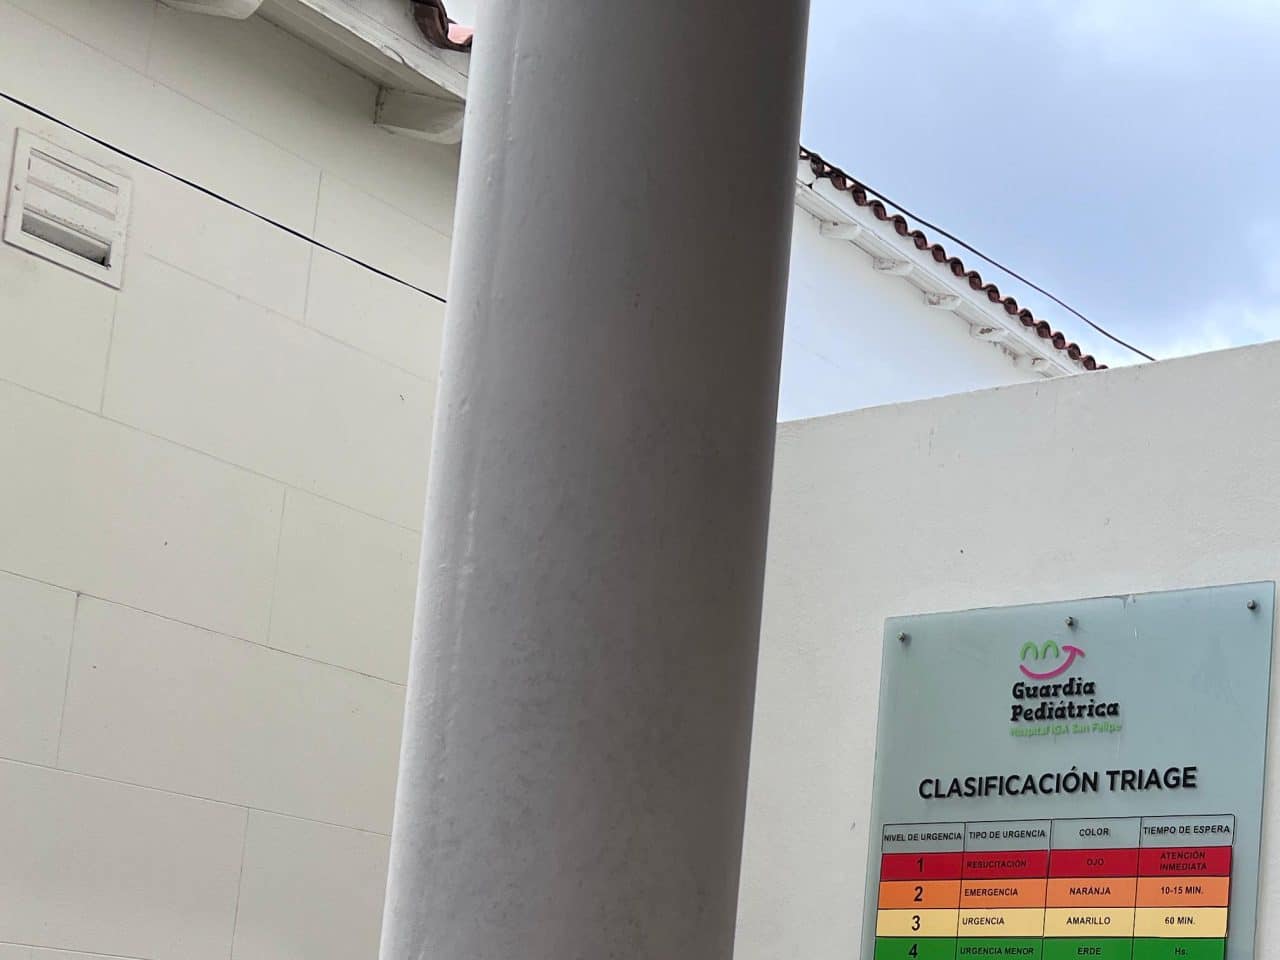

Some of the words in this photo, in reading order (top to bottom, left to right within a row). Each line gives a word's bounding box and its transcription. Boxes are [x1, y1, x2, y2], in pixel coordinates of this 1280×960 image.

[1012, 677, 1096, 700] Guardia
[1010, 699, 1120, 722] Pediátrica
[918, 766, 1099, 800] CLASIFICACIÓN
[1106, 766, 1198, 792] TRIAGE
[969, 831, 987, 839] TIPO
[989, 831, 1001, 839] DE
[1002, 829, 1046, 838] URGENCIA
[1079, 828, 1110, 837] COLOR
[1143, 826, 1176, 835] TIEMPO
[1178, 826, 1191, 834] DE
[1193, 824, 1231, 834] ESPERA
[883, 833, 906, 842] NIVEL
[908, 833, 919, 841] DE
[921, 832, 962, 841] URGENCIA
[916, 858, 924, 873] 1
[914, 886, 924, 902] 2
[964, 888, 1018, 897] EMERGENCIA
[1161, 886, 1183, 895] 10-15
[911, 915, 921, 931] 3
[962, 917, 1005, 926] URGENCIA
[1066, 916, 1111, 925] AMARILLO
[1164, 917, 1175, 925] 60
[908, 943, 918, 959] 4
[960, 947, 1002, 956] URGENCIA
[1004, 947, 1034, 955] MENOR
